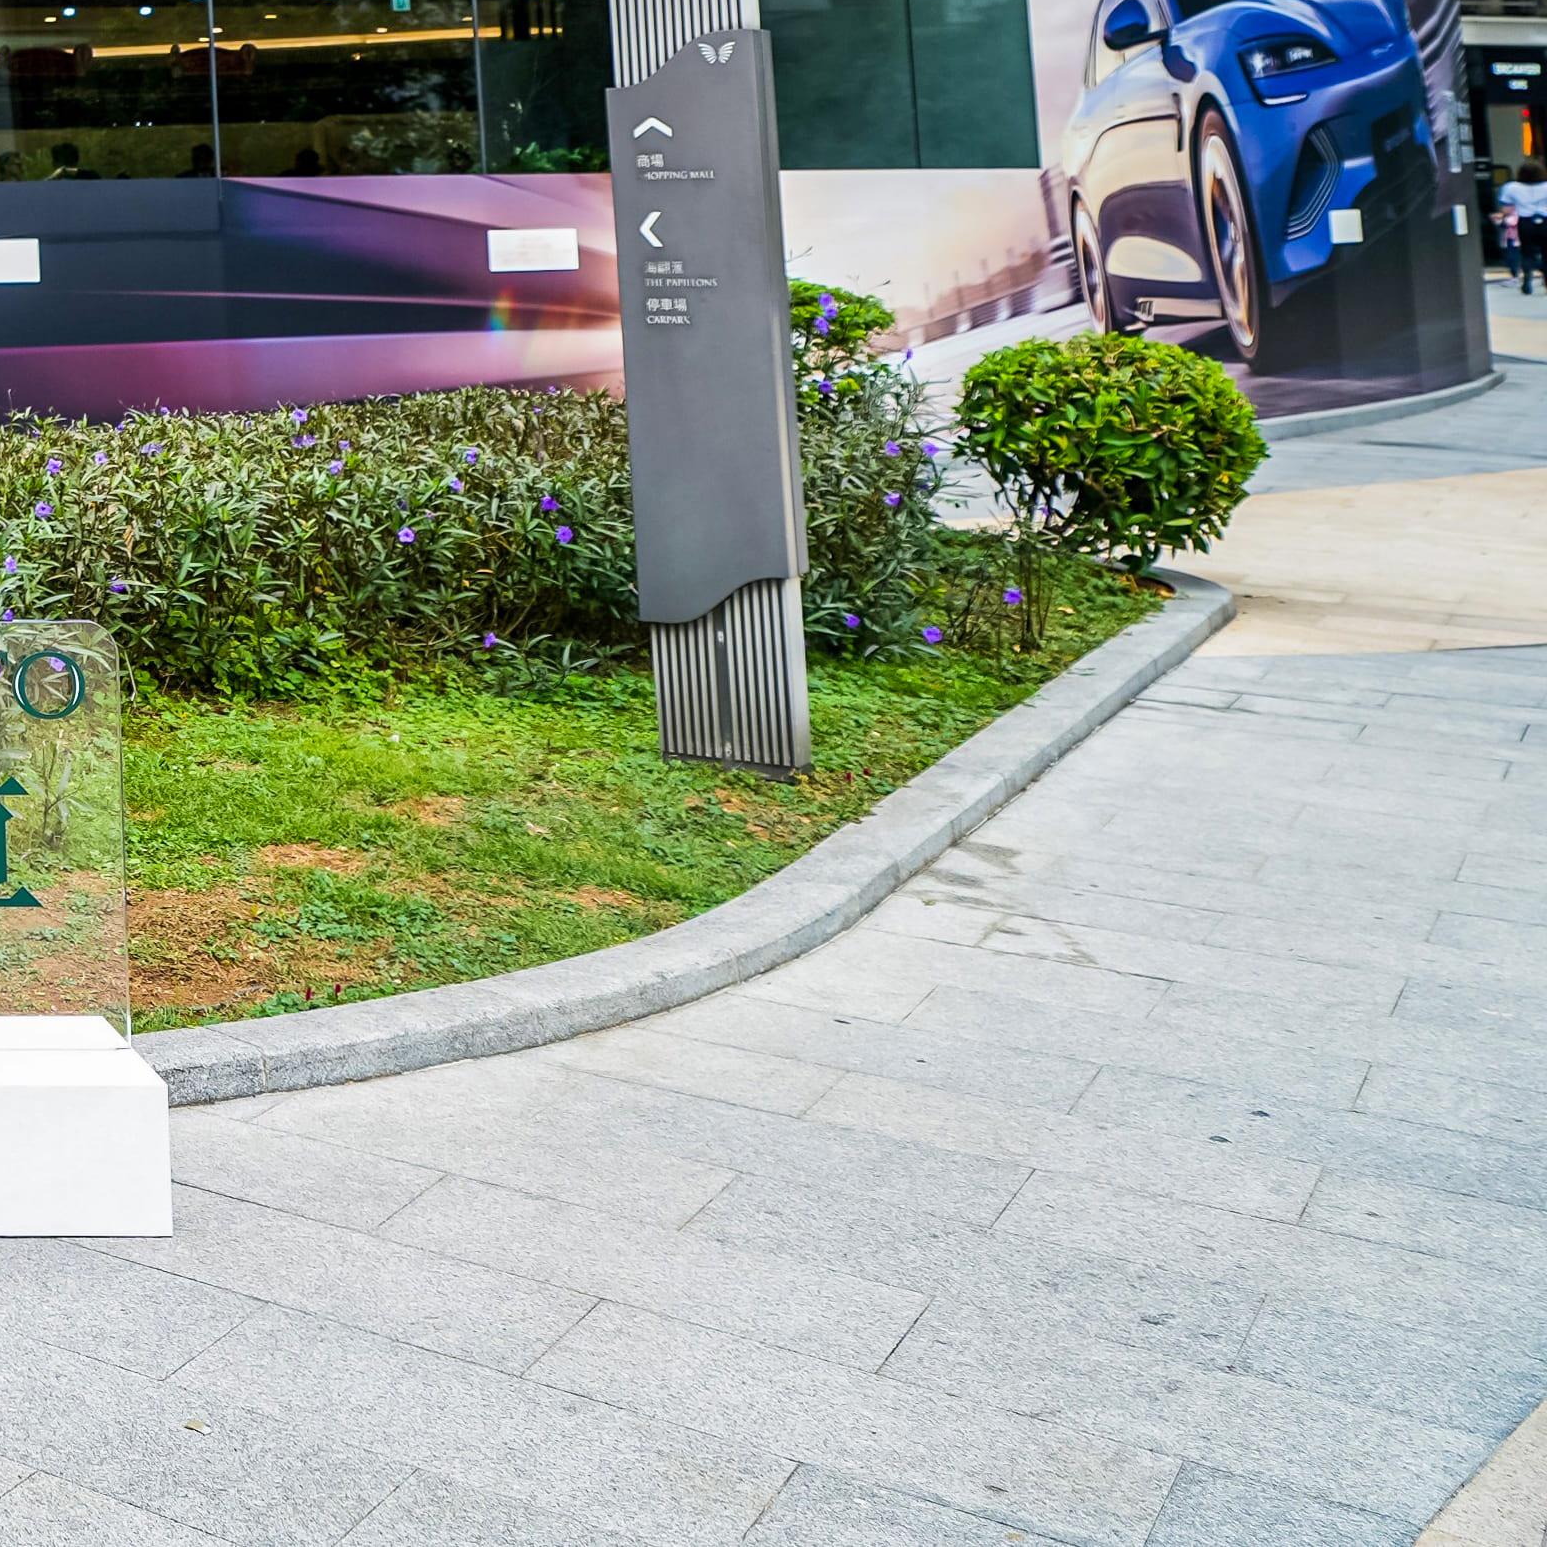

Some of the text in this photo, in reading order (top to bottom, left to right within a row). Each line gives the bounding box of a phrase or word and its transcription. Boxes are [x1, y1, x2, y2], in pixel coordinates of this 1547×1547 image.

[645, 278, 662, 288] THE
[646, 297, 688, 312] 停車場
